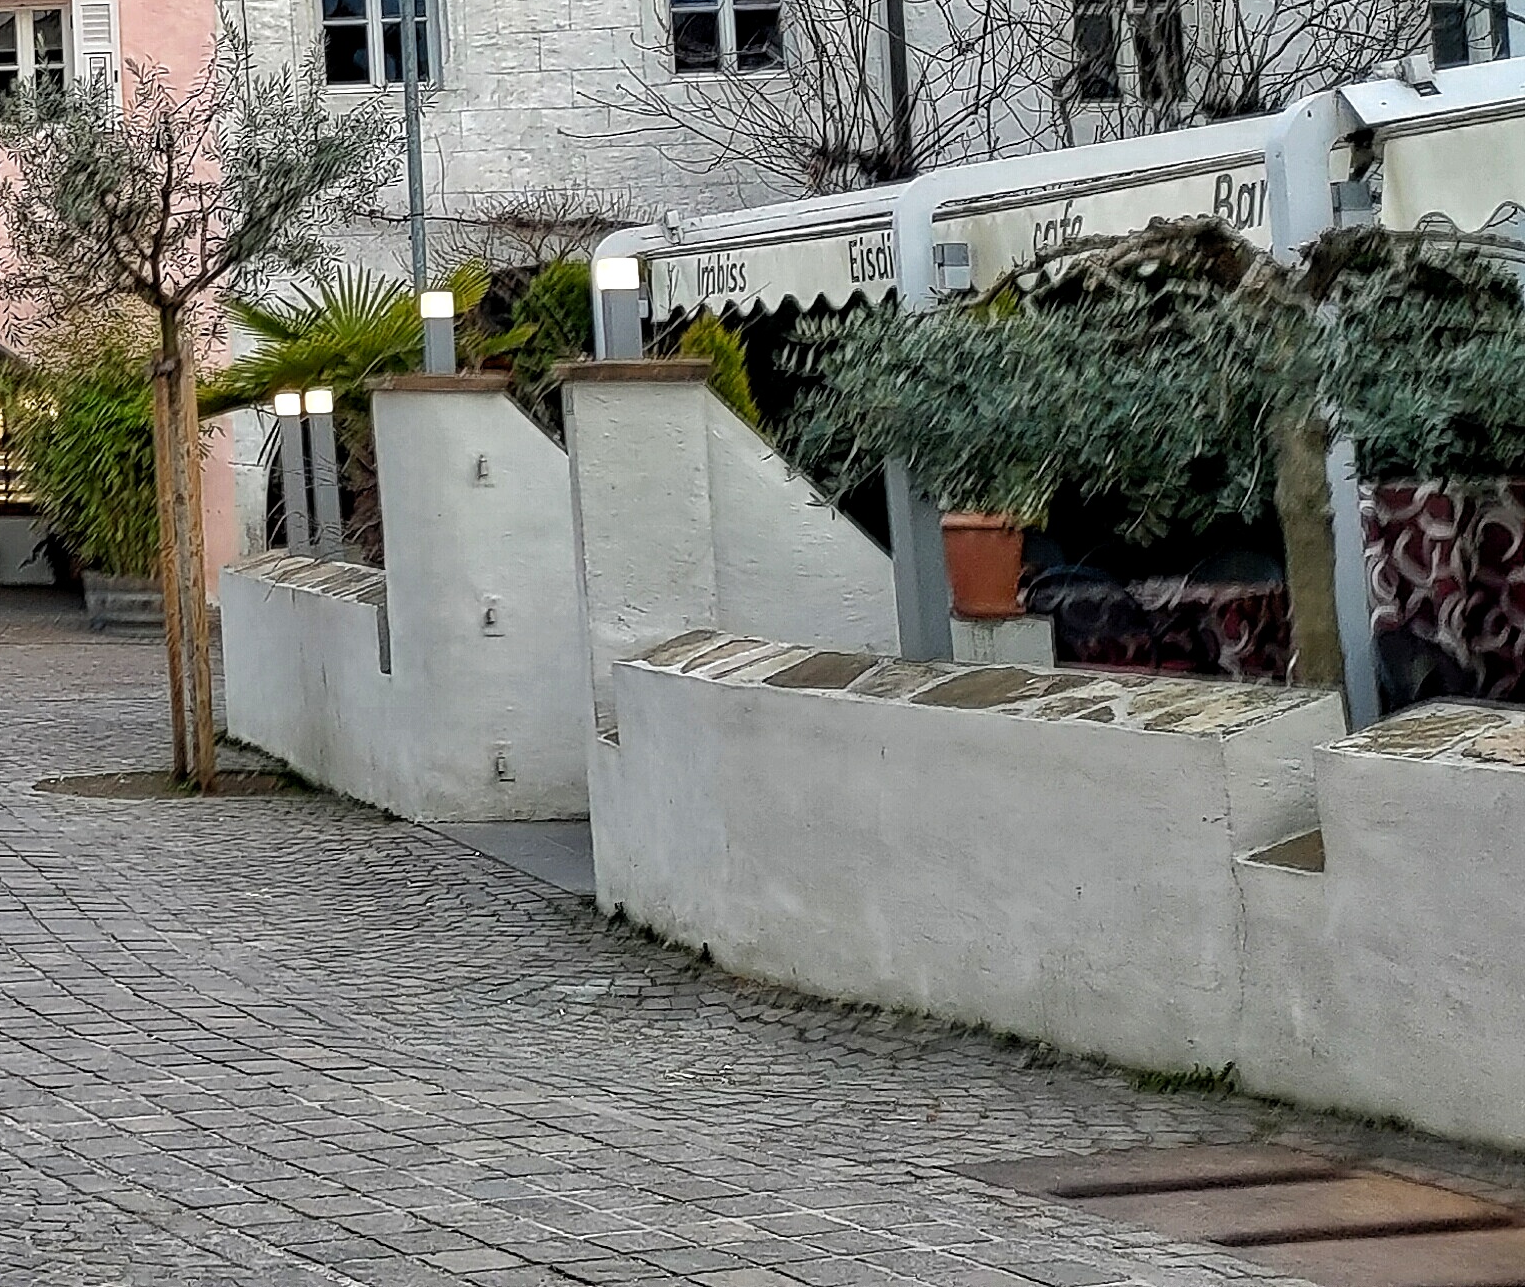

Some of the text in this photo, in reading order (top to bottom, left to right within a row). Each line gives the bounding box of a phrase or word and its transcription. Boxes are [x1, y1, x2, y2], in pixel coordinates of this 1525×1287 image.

[1213, 173, 1269, 231] Bar
[697, 252, 747, 297] Imbiss
[848, 232, 895, 283] Eisdi
